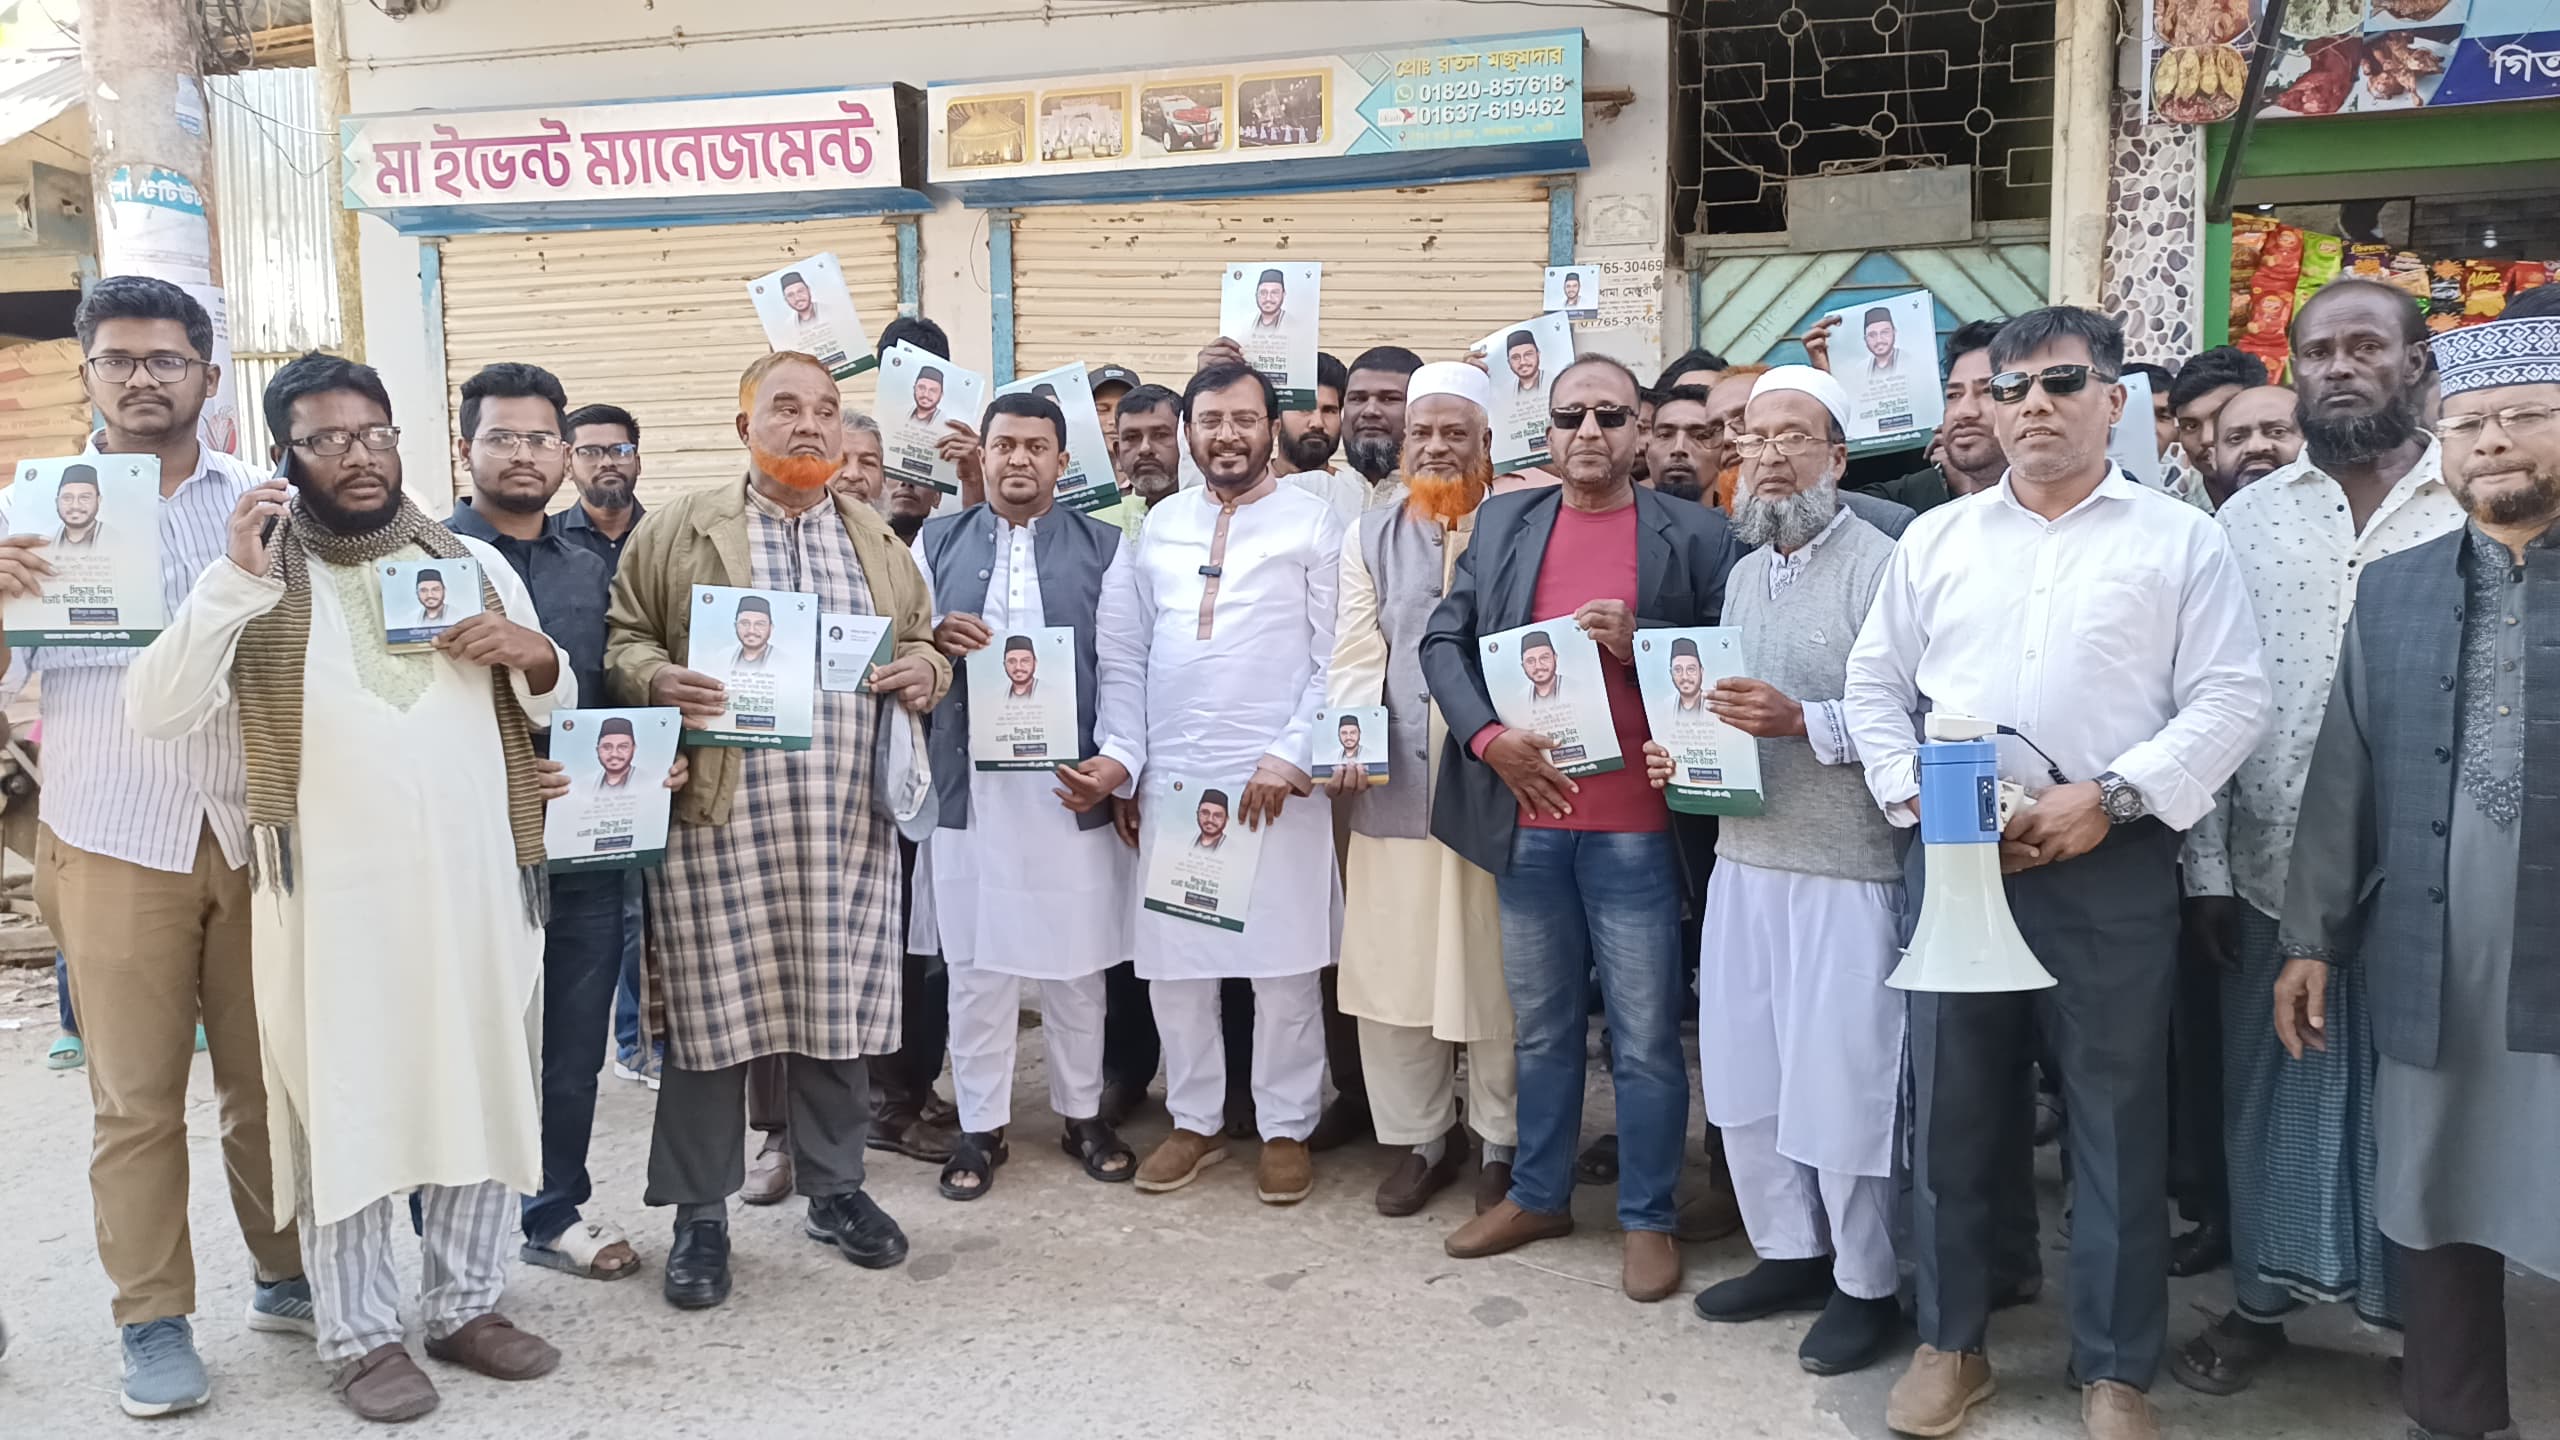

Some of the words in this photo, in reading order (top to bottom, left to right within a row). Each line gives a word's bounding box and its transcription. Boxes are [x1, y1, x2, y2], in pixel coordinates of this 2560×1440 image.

[1394, 57, 1431, 78] প্রোঃ
[1438, 53, 1481, 74] রতন
[1487, 46, 1565, 73] মজুমদার
[1419, 73, 1567, 103] 01820-857618
[1419, 95, 1566, 125] 01637-619462
[372, 141, 421, 194] মা
[430, 118, 571, 198] ইভেন্ট
[580, 100, 874, 187] ম্যানেজমেন্ট
